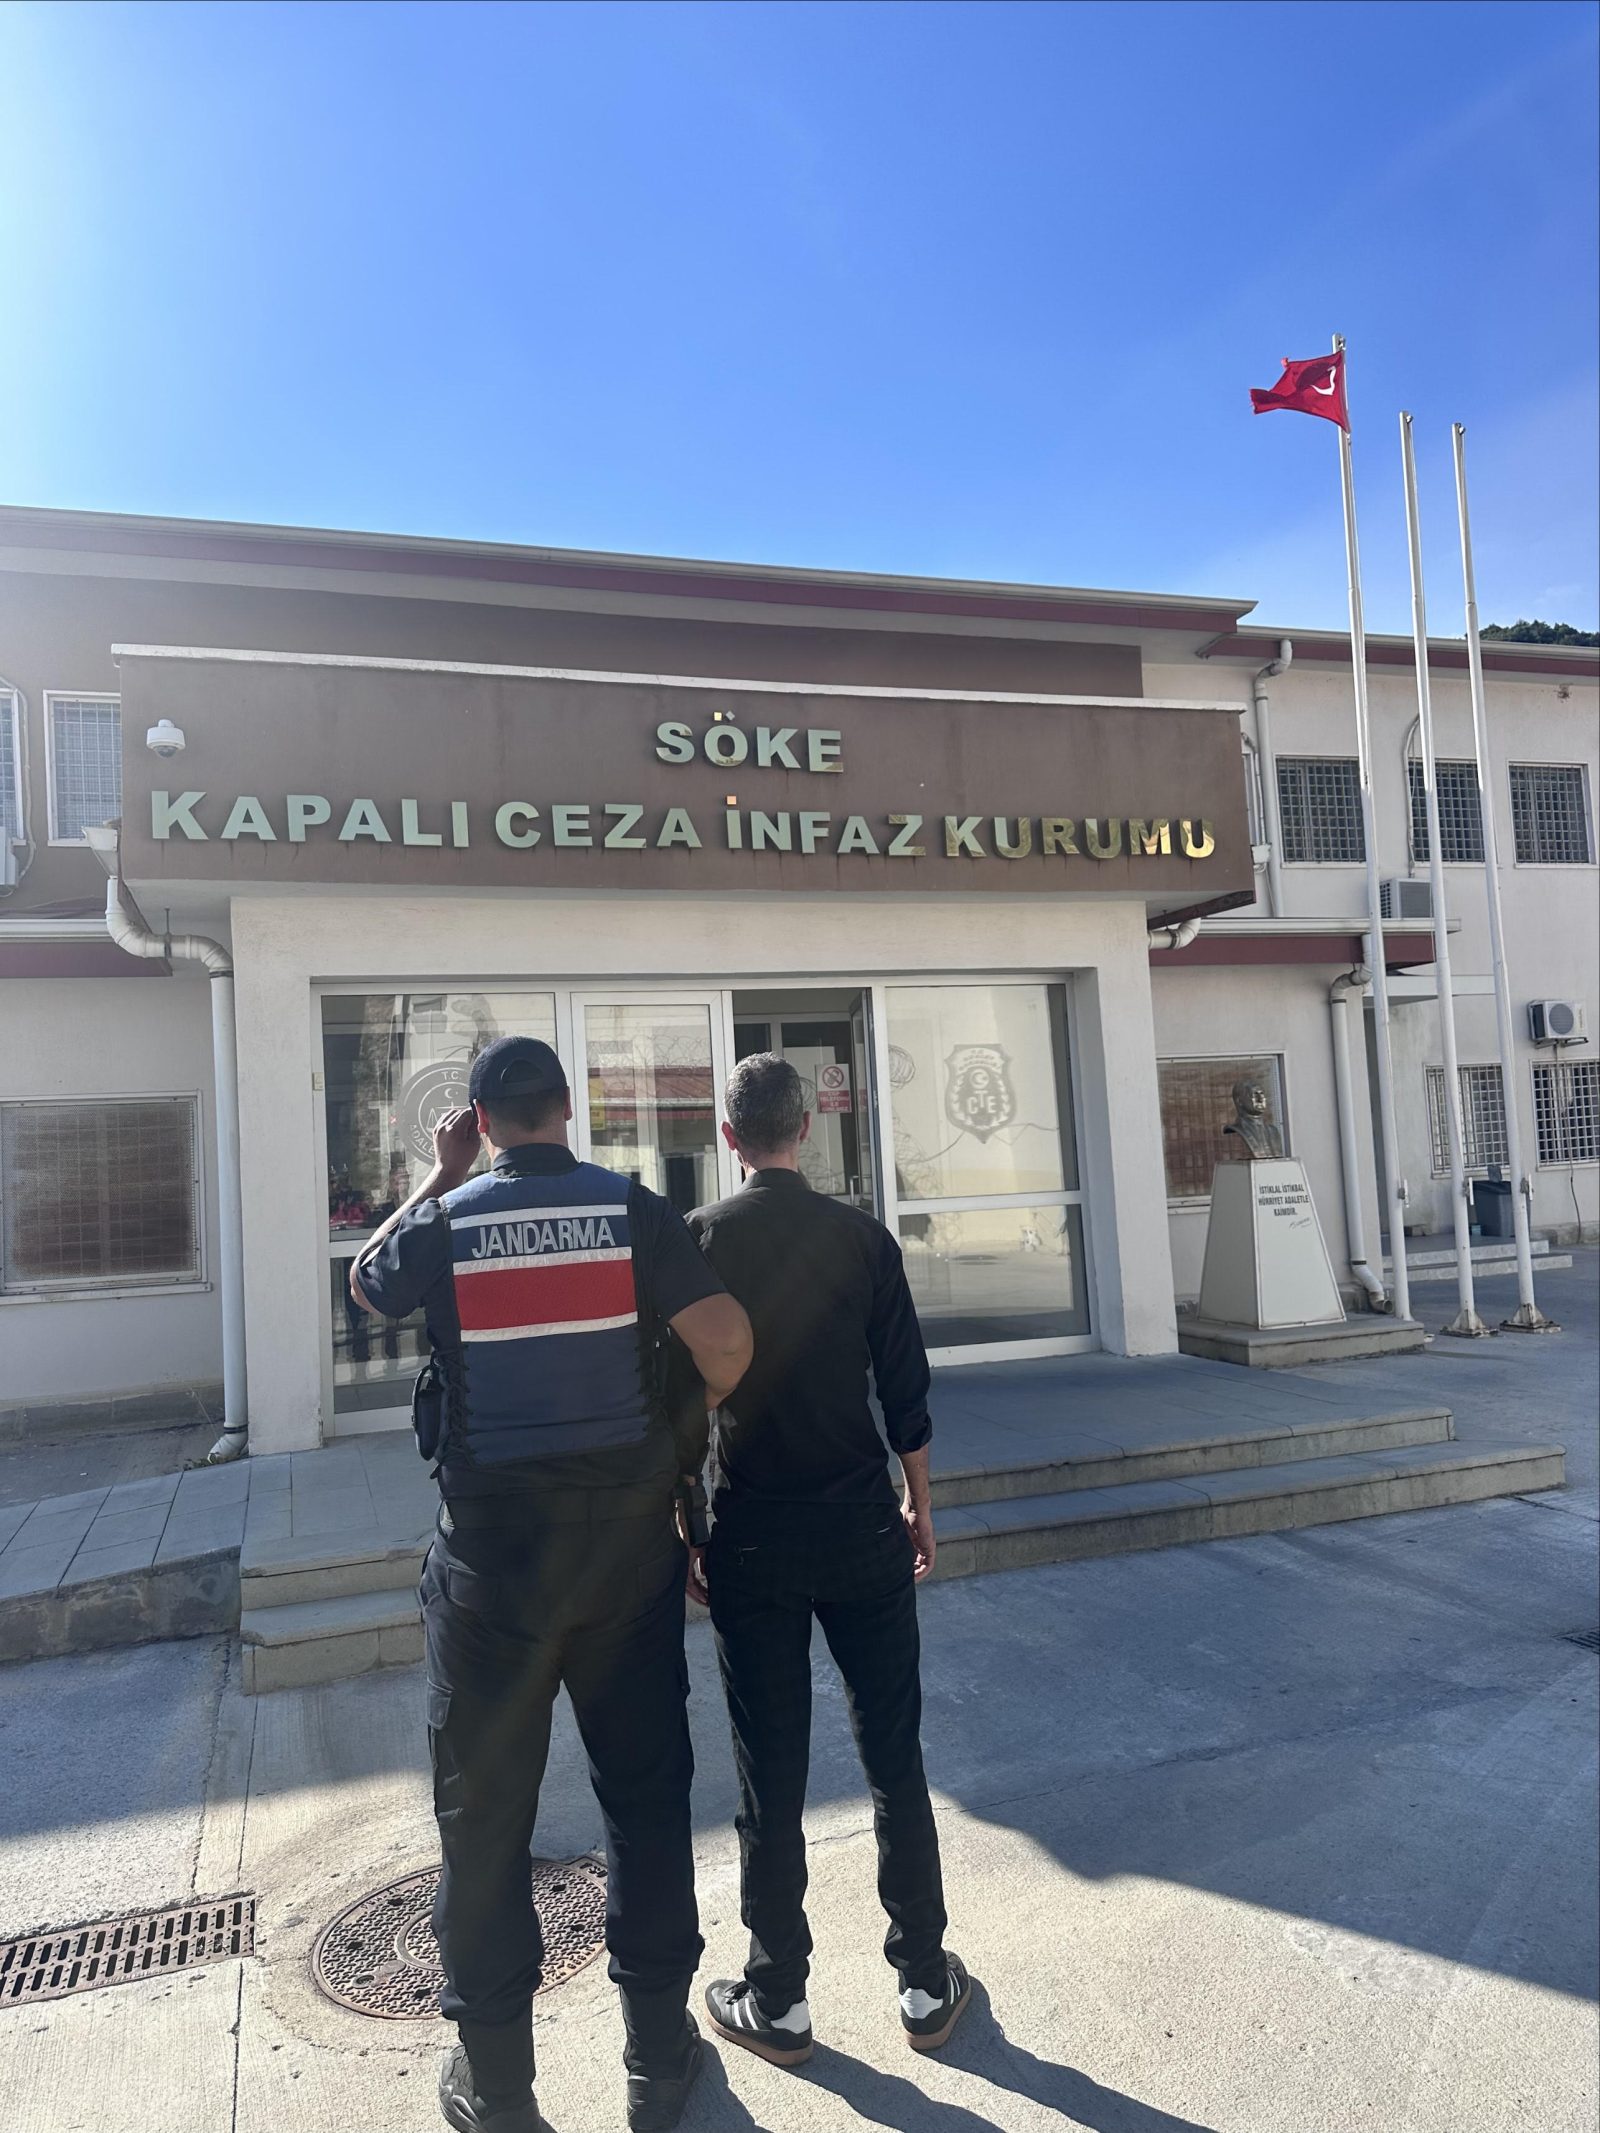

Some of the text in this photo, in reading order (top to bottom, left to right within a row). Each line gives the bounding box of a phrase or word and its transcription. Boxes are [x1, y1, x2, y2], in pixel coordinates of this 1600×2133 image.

[656, 711, 844, 773] SÖKE
[151, 790, 1216, 860] KAPALI CEZA İNFAZ KURUMU
[441, 1070, 462, 1081] T.C.
[409, 1124, 436, 1155] ADALE
[471, 1217, 616, 1258] JANDARMA
